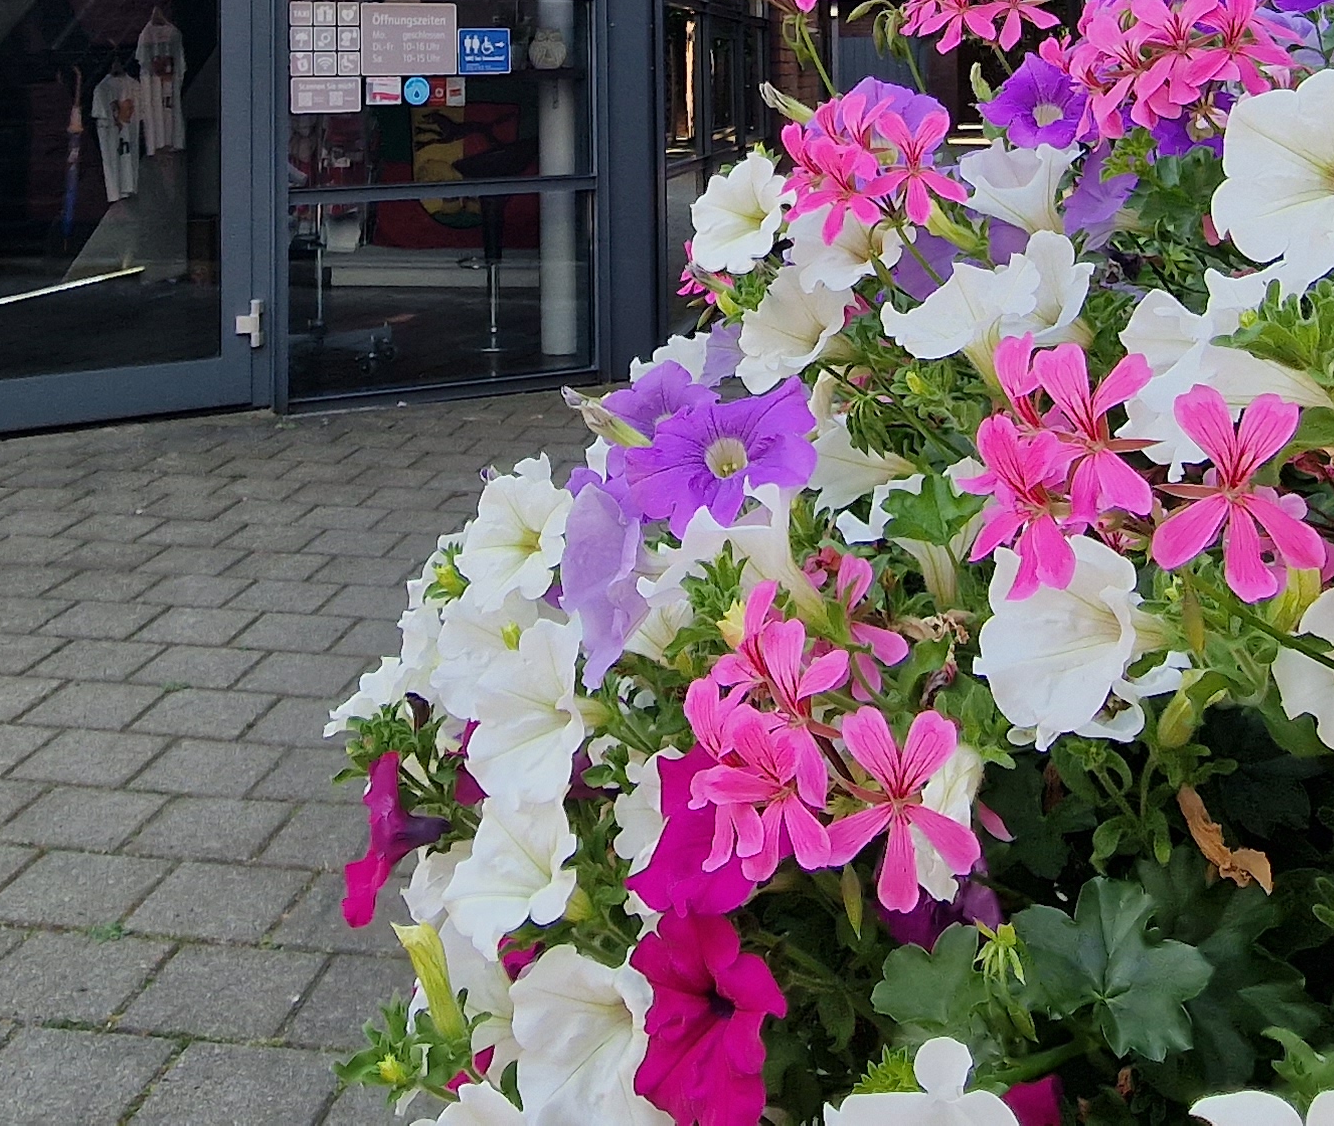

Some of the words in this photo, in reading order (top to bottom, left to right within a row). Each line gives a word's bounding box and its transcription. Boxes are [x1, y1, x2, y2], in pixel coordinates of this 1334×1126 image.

[293, 10, 310, 18] TAXI
[372, 12, 446, 27] Öffnungszeiten
[402, 30, 445, 41] geschlossen
[426, 42, 440, 51] Uhr
[426, 54, 441, 63] Uhr
